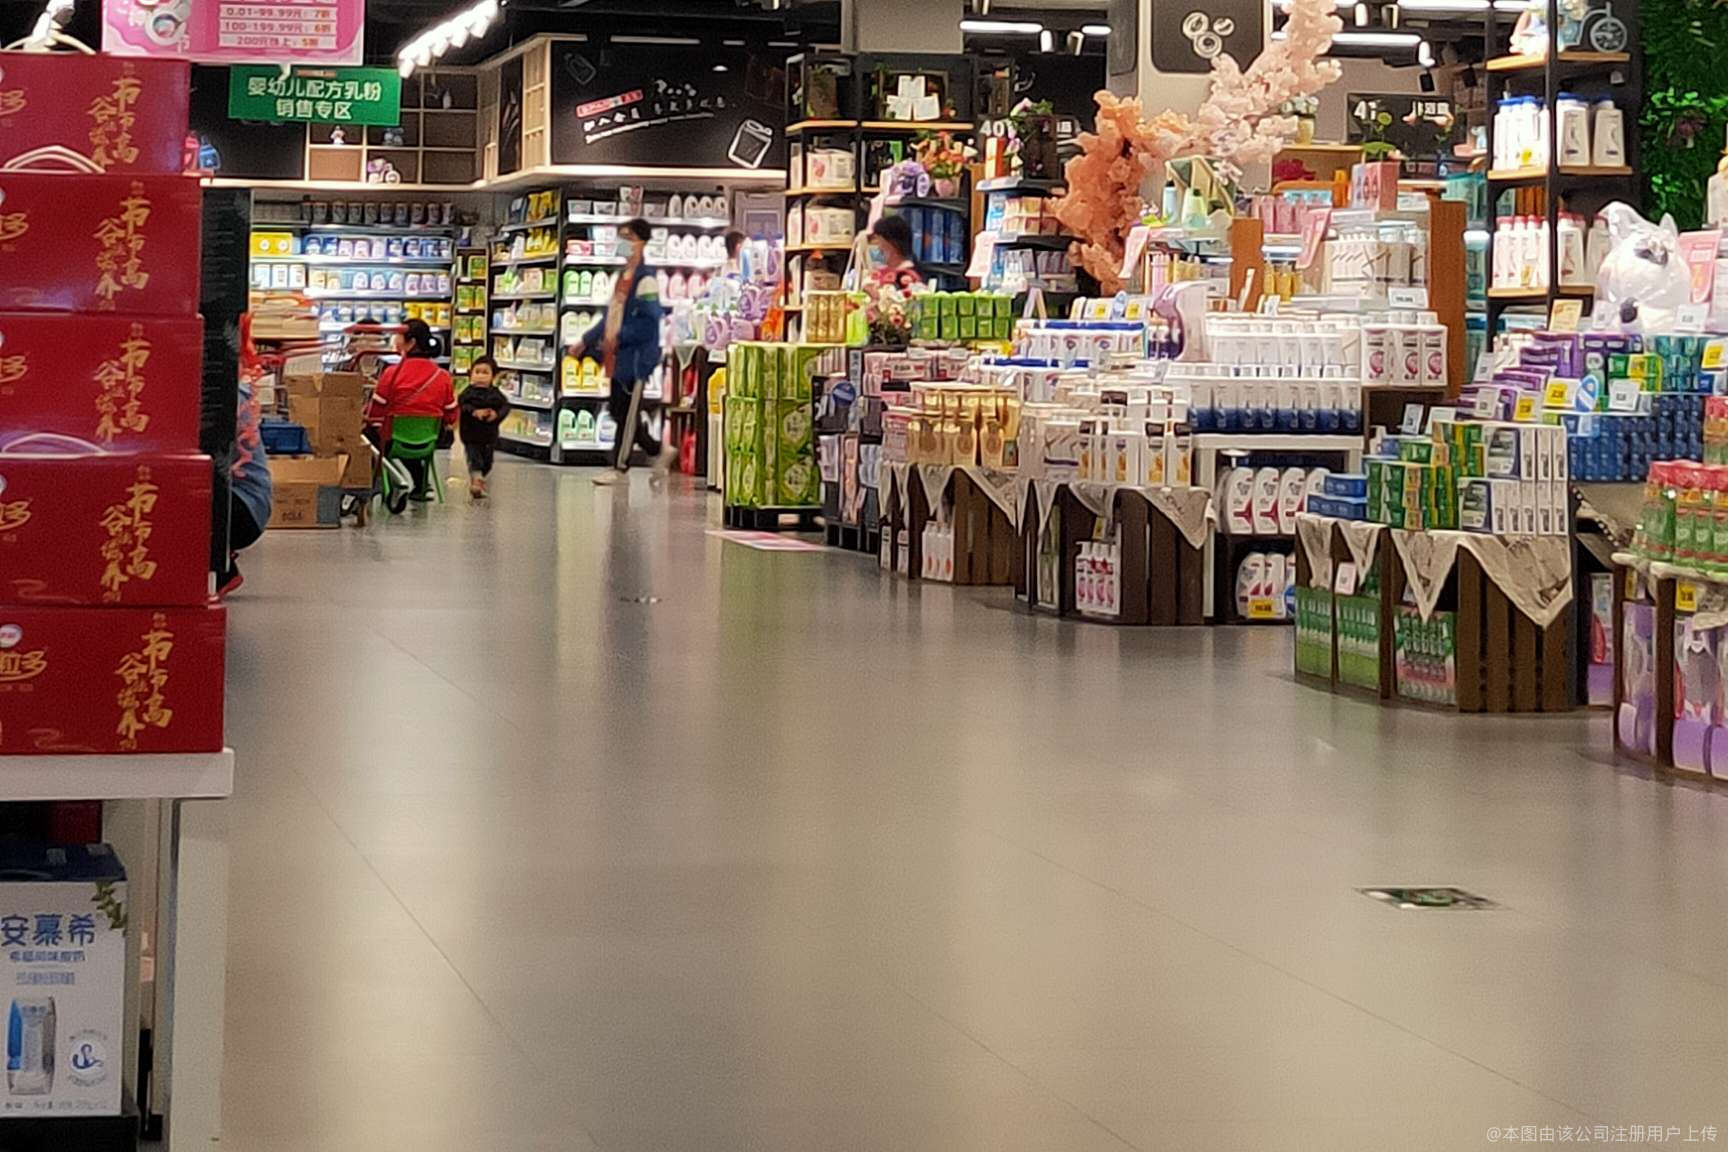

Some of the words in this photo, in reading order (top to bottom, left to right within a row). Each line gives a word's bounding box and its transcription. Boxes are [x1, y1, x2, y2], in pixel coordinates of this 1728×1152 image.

[247, 76, 382, 102] 婴幼儿配方乳粉
[275, 98, 353, 120] 销售专区
[1, 914, 96, 947] 安慕希
